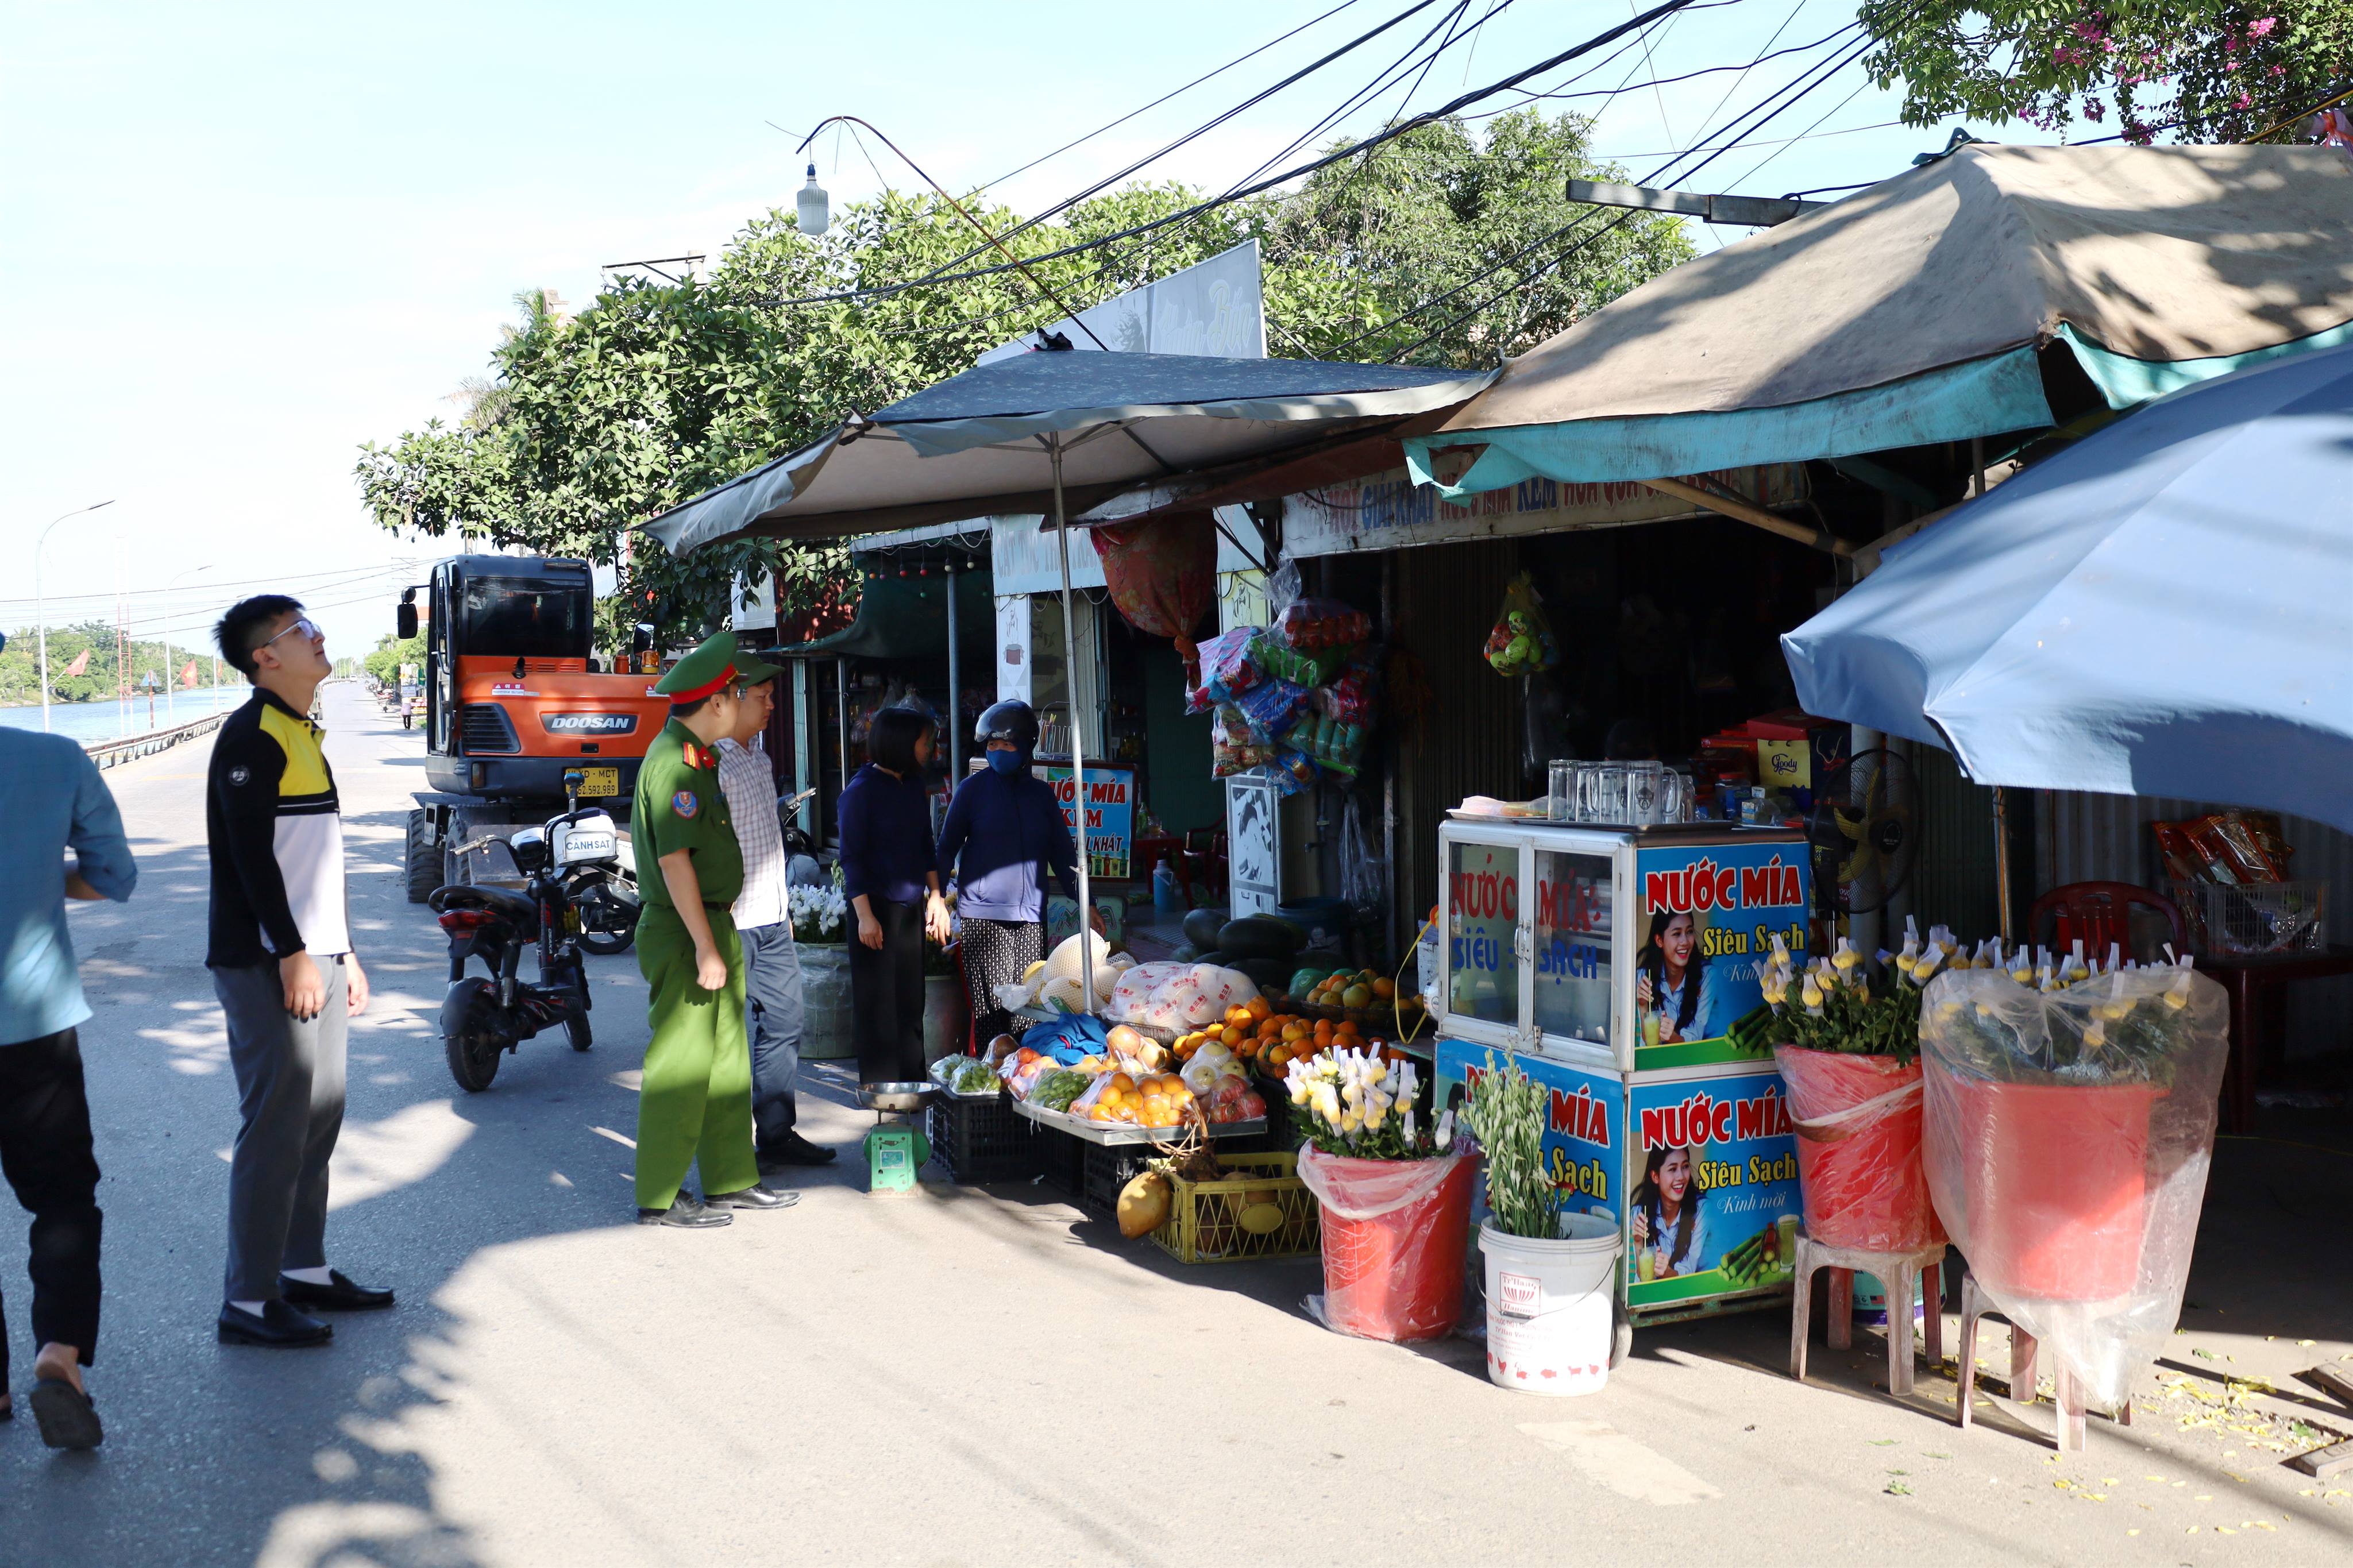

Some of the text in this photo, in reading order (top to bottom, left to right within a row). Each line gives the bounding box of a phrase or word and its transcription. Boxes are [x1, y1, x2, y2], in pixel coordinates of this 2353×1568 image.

[551, 717, 629, 728] DOOSAN
[599, 770, 616, 778] MCT
[1772, 754, 1797, 775] Goody
[1090, 777, 1127, 804] MÍA
[1093, 833, 1124, 852] KHÁT
[1449, 853, 1517, 921] NƯỚC
[1646, 853, 1803, 915] NƯỚC MÍA
[1703, 926, 1748, 957] Siêu
[1538, 939, 1597, 985] SẠCH
[1550, 1082, 1610, 1149] MÍA
[1640, 1084, 1795, 1152] NƯỚC MÍA
[1698, 1152, 1797, 1191] Siêu Sạch
